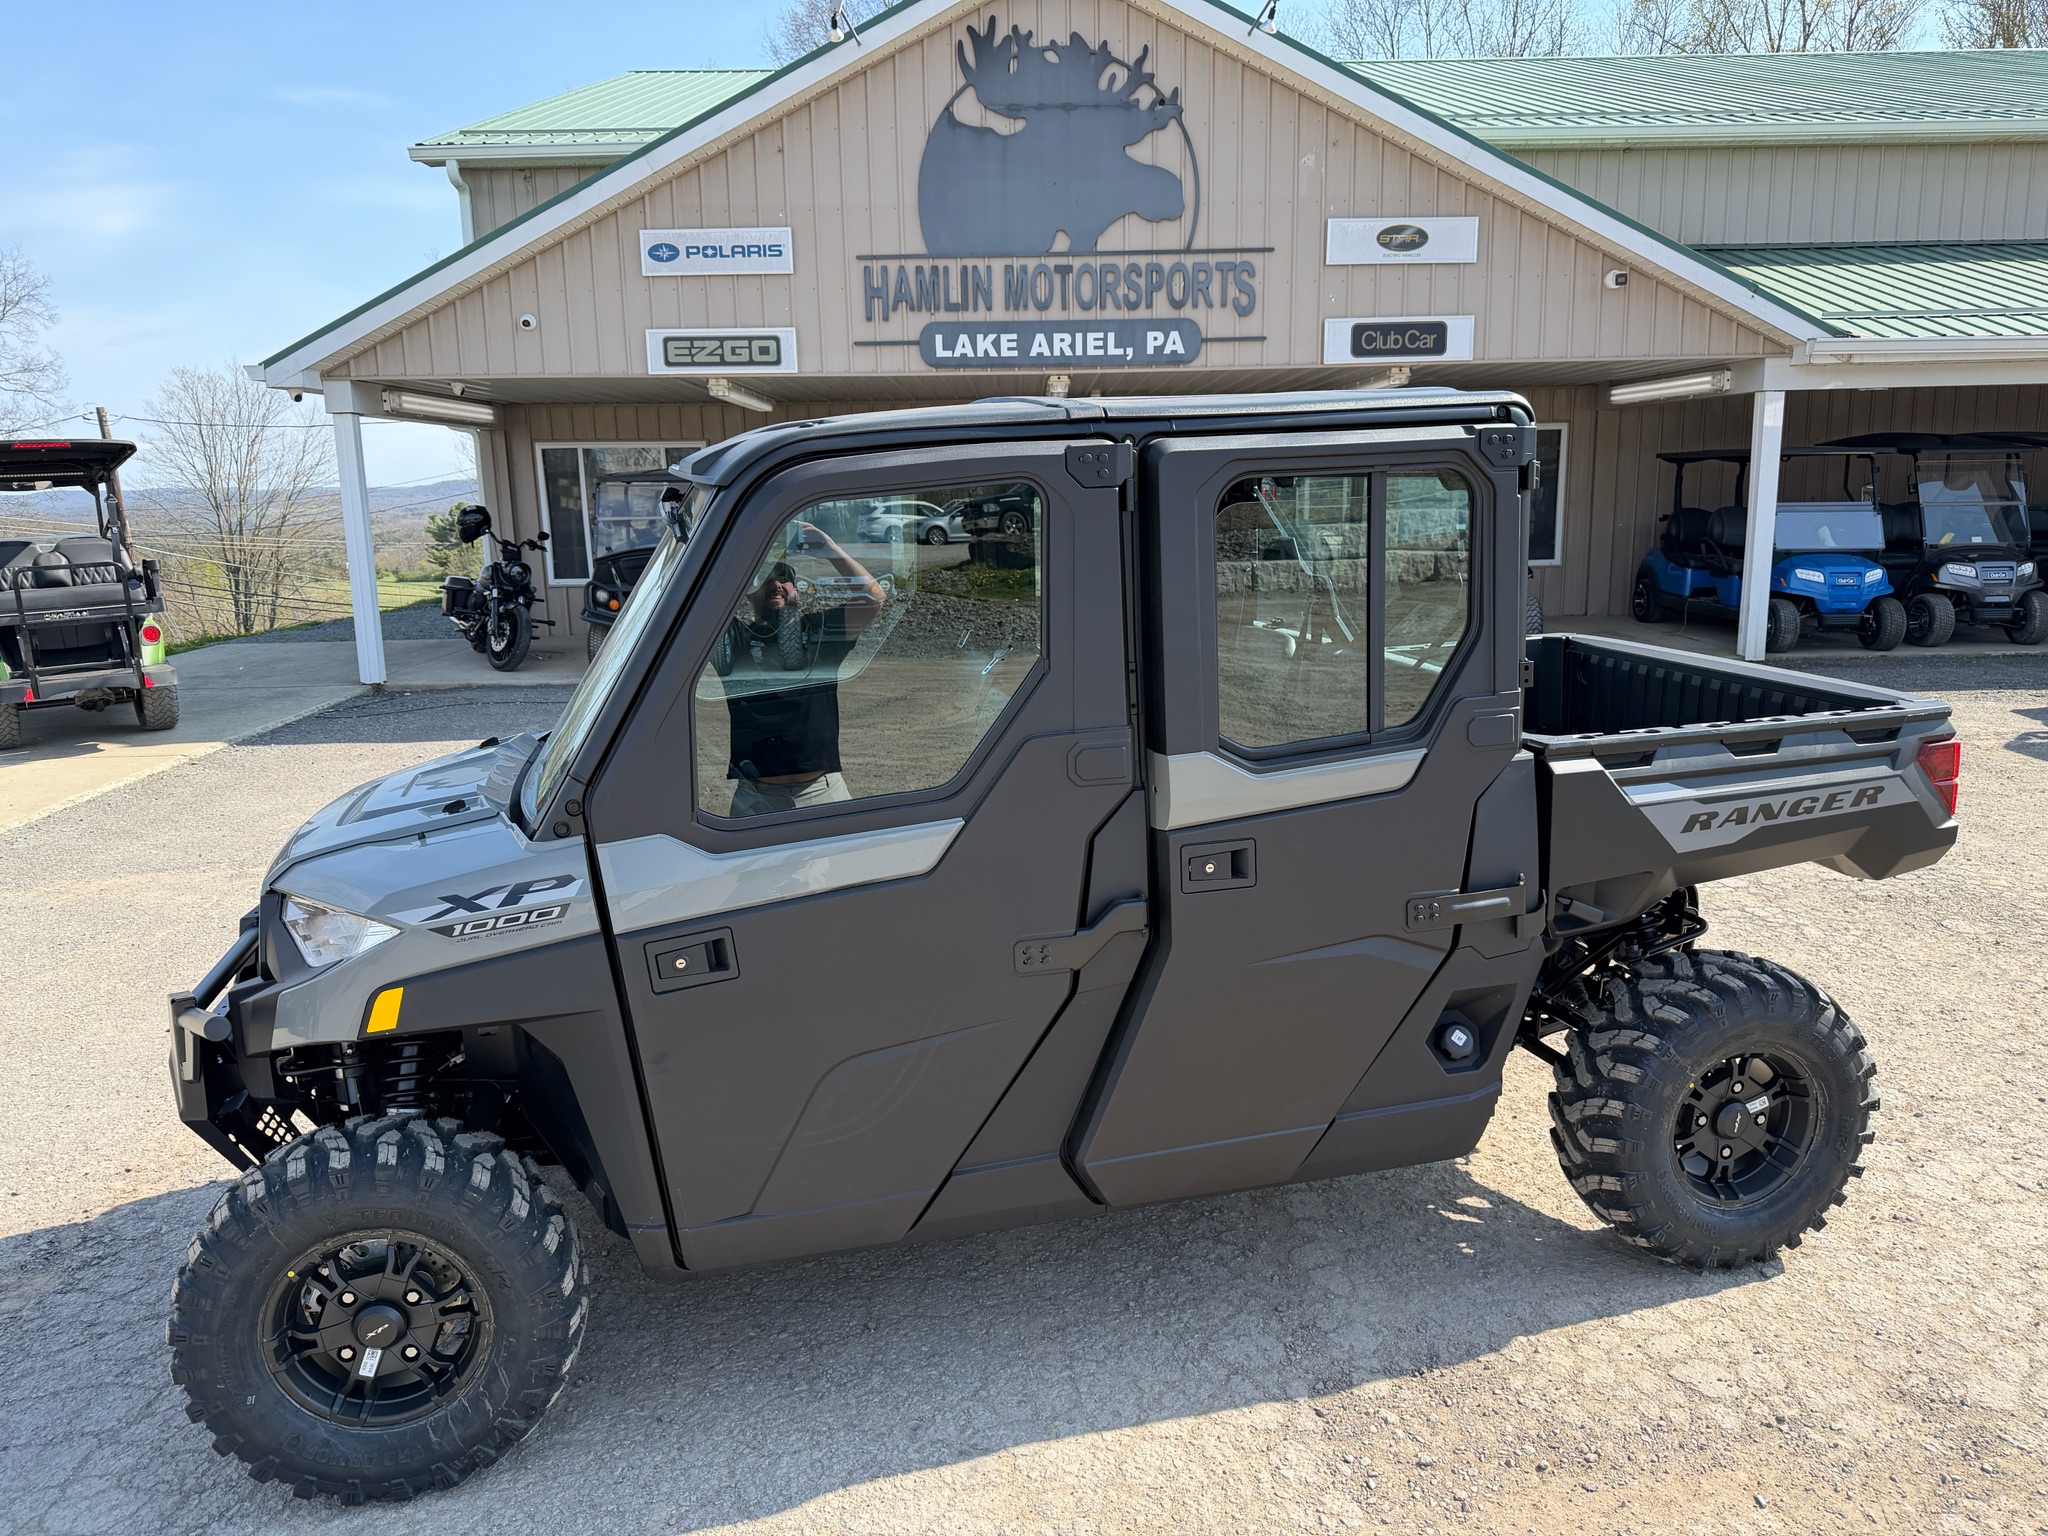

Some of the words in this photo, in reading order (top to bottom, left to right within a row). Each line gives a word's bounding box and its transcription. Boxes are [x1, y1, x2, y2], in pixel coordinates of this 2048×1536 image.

[685, 243, 783, 259] POLARIS
[1379, 234, 1419, 243] STAR
[863, 263, 993, 322] HAMLIN
[1004, 260, 1257, 317] MOTORSPORTS
[666, 339, 778, 363] EZGO
[935, 332, 1018, 358] LAKE
[1029, 331, 1134, 361] ARIEL,
[1146, 330, 1186, 355] PA
[1361, 330, 1402, 349] Club
[1405, 329, 1437, 349] Car
[1679, 785, 1885, 834] RANGER
[417, 874, 578, 923] XP
[451, 906, 562, 937] 1000
[456, 935, 483, 943] DUAL
[485, 924, 539, 938] OVERHEAD
[540, 920, 563, 928] CAM
[322, 1208, 465, 1242] X-TERRAIN
